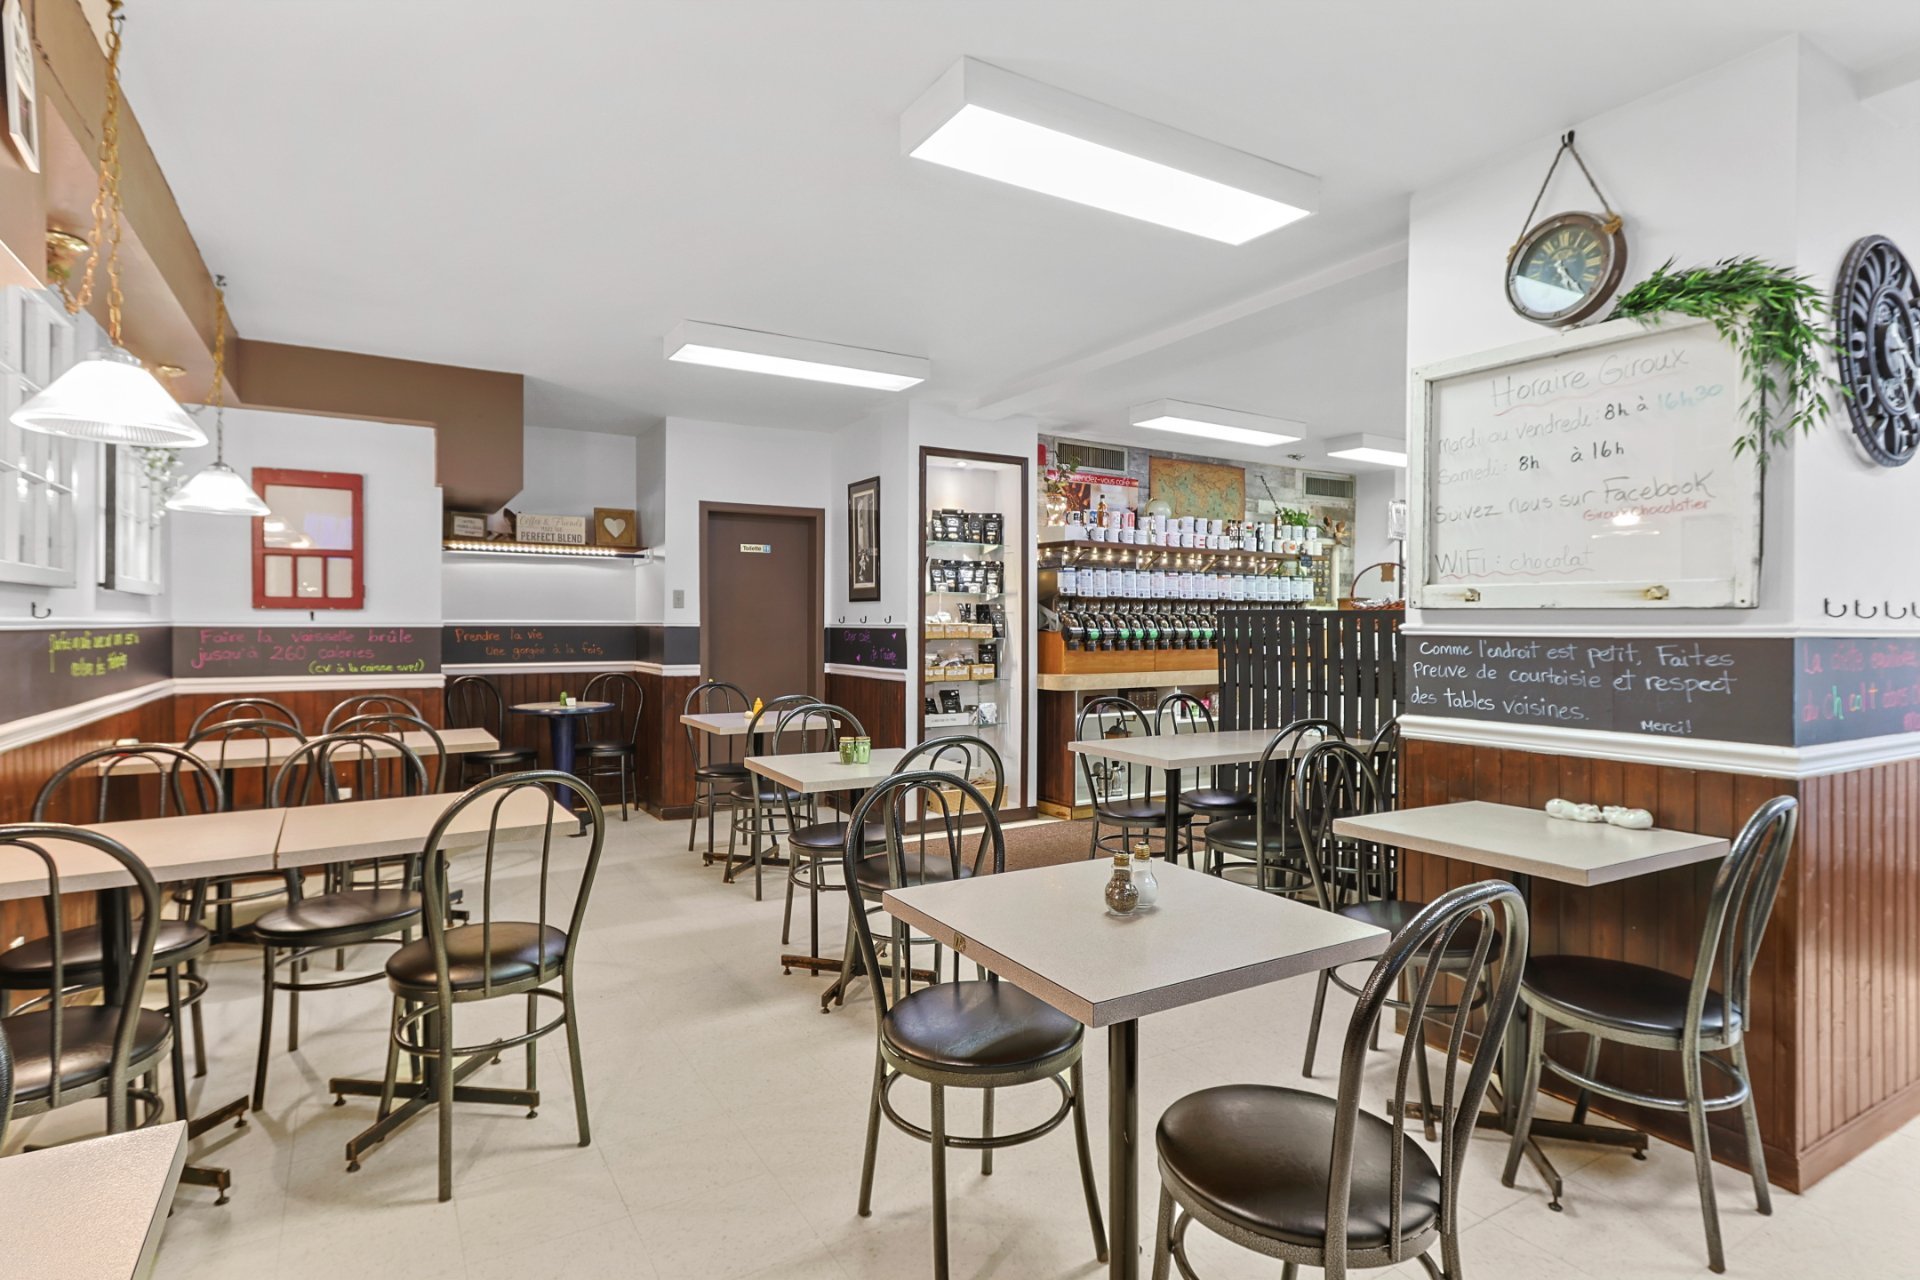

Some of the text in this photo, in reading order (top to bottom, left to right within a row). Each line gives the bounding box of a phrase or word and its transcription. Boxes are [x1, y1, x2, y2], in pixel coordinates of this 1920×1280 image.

[1492, 349, 1689, 407] Horaire Giroux
[1604, 402, 1630, 420] 8h
[1636, 395, 1649, 411] à
[1518, 455, 1539, 471] 8h
[1570, 446, 1584, 463] à
[1593, 440, 1625, 459] 16h
[1434, 504, 1502, 524] Suivez
[1558, 490, 1597, 508] sur
[520, 531, 583, 544] PERFECT BLEND
[1510, 545, 1595, 573] chocolat
[200, 629, 245, 643] Faire
[257, 628, 272, 642] la
[368, 627, 414, 643] brûle
[455, 628, 545, 643] Prendre la vie
[269, 645, 306, 660] 260
[318, 646, 375, 659] calories
[1420, 639, 1735, 669] Comme l'endroit est petit, Faites
[1476, 663, 1497, 680] de
[1509, 667, 1602, 689] courtoisie
[1613, 669, 1636, 691] et
[1645, 670, 1737, 703] respect
[1411, 686, 1590, 721] des tables voisines.
[1640, 719, 1692, 734] Merci!
